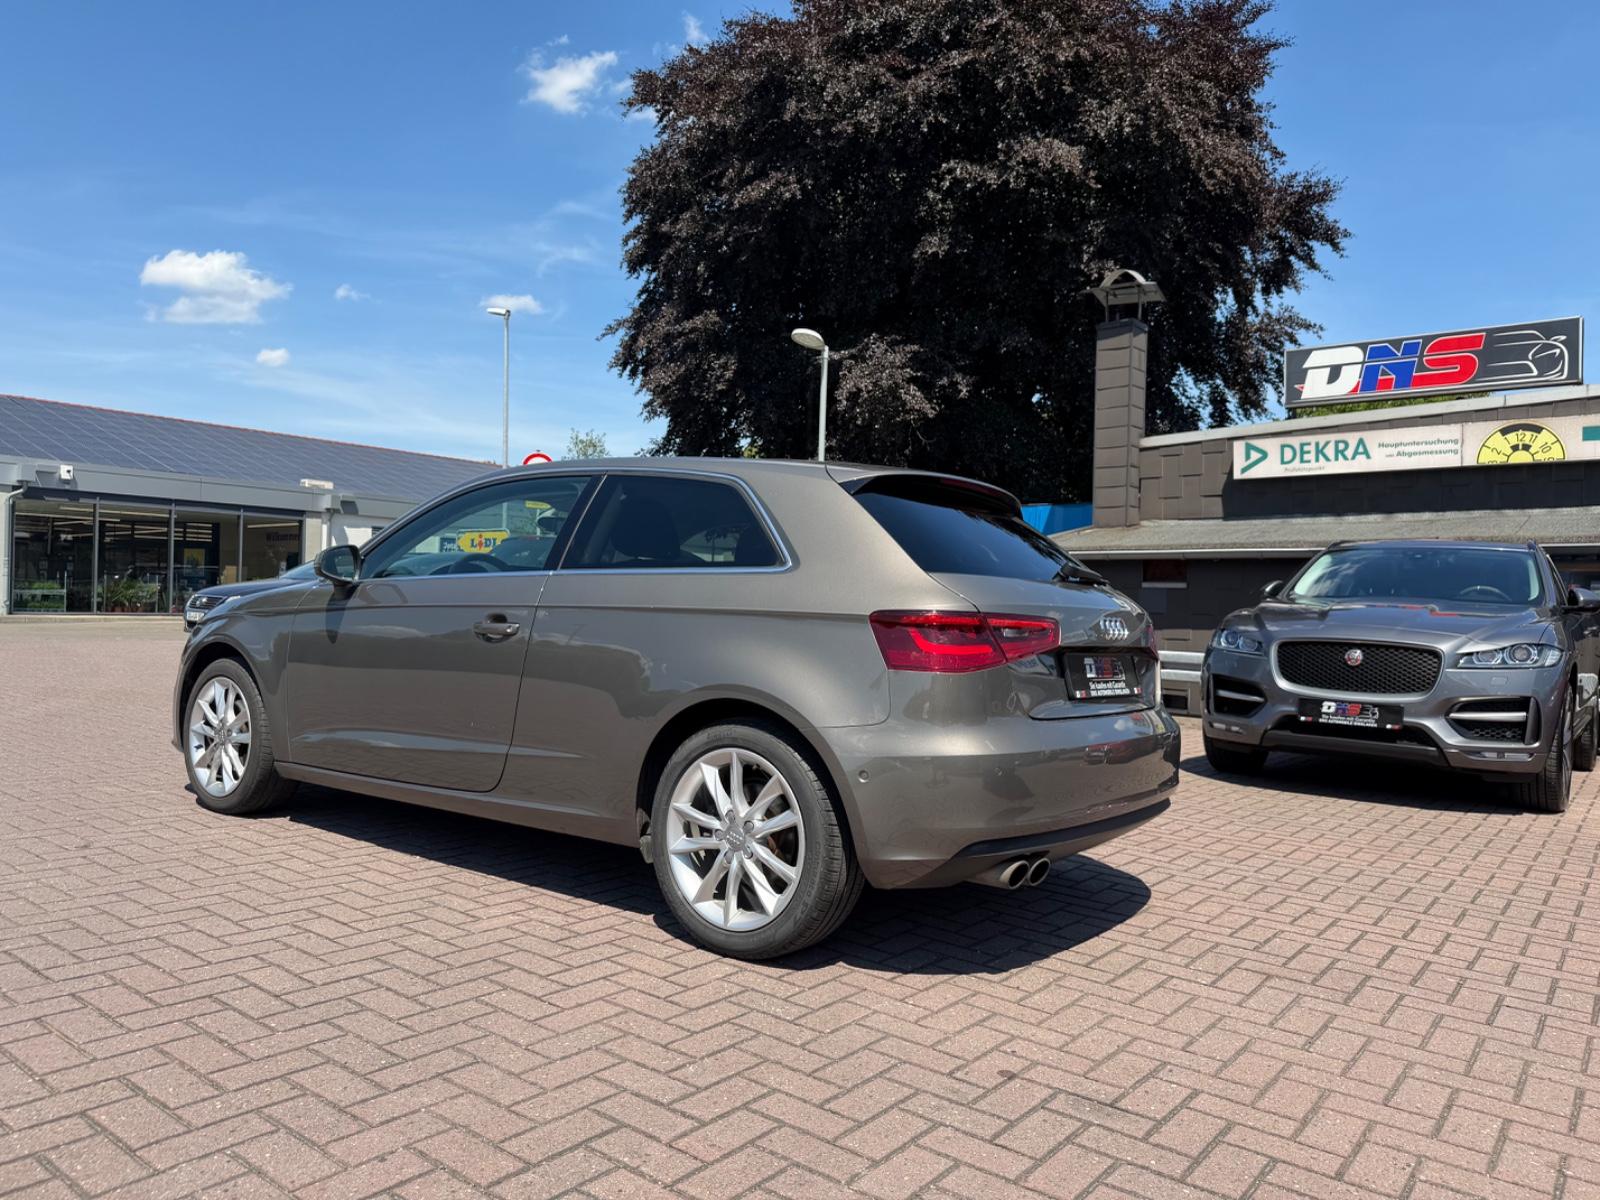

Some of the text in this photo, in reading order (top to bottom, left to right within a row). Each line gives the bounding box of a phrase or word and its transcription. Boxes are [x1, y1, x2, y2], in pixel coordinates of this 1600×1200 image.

[1300, 332, 1486, 400] DNS
[1504, 436, 1511, 445] 1
[1515, 432, 1527, 443] 12
[1529, 433, 1538, 444] 11
[1378, 438, 1459, 449] Hauptuntersuchung
[1539, 442, 1553, 454] 10
[1280, 437, 1372, 465] DEKRA
[1490, 447, 1502, 456] 2
